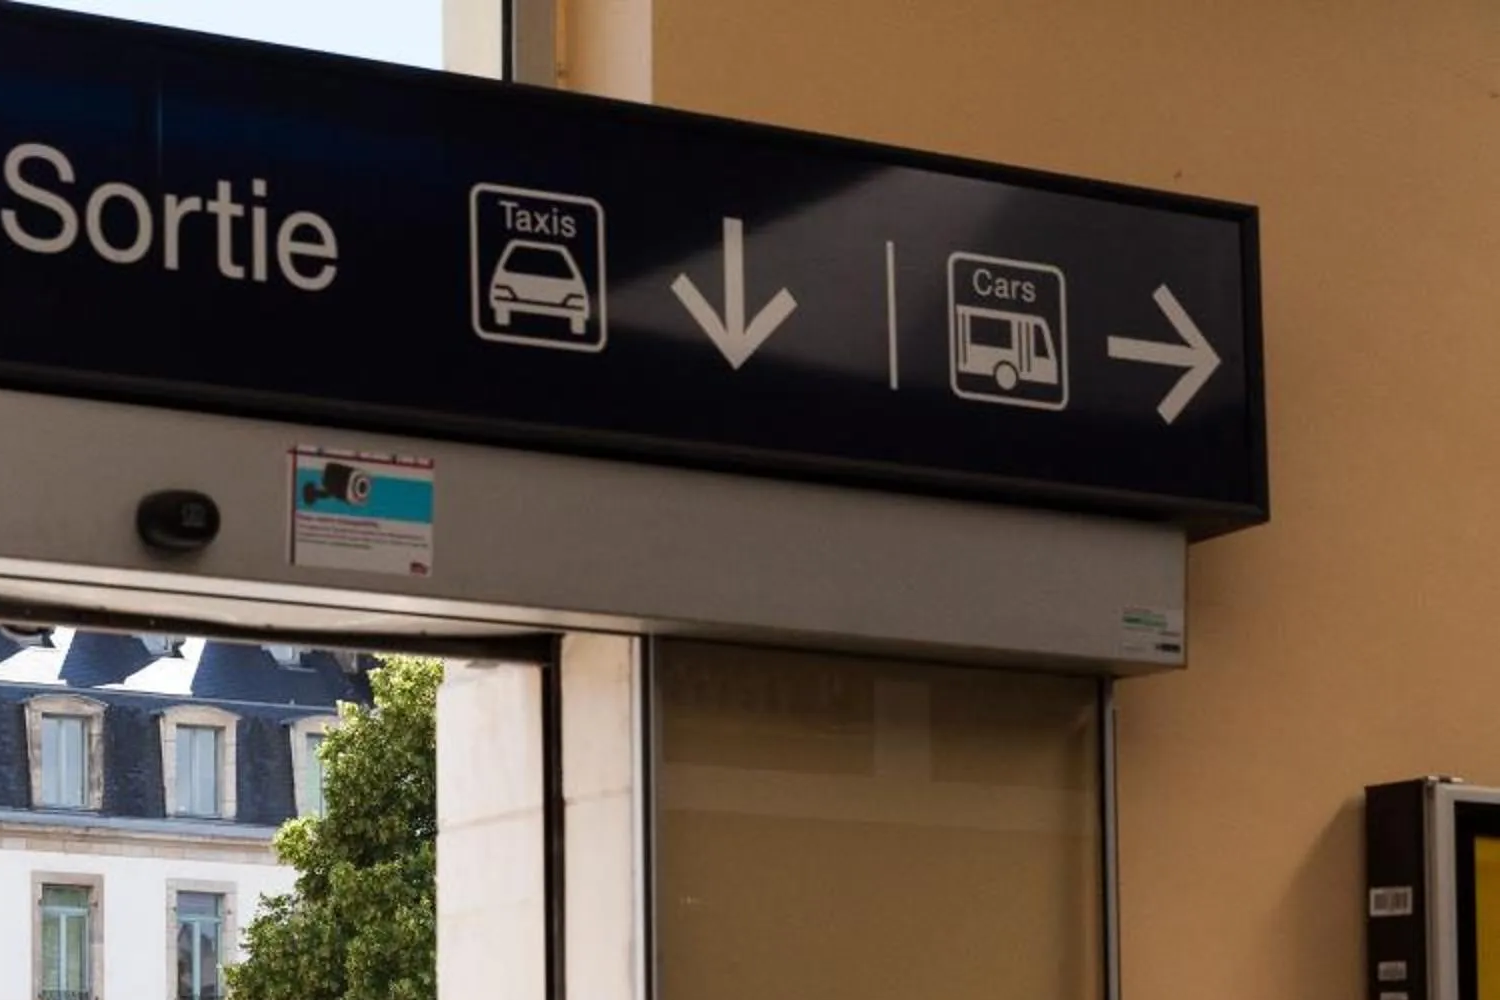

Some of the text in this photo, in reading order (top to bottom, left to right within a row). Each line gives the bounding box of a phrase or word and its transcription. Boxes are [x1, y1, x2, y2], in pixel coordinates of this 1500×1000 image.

[0, 143, 339, 291] Sortie
[500, 201, 577, 239] Taxis
[973, 269, 1037, 304] Cars
